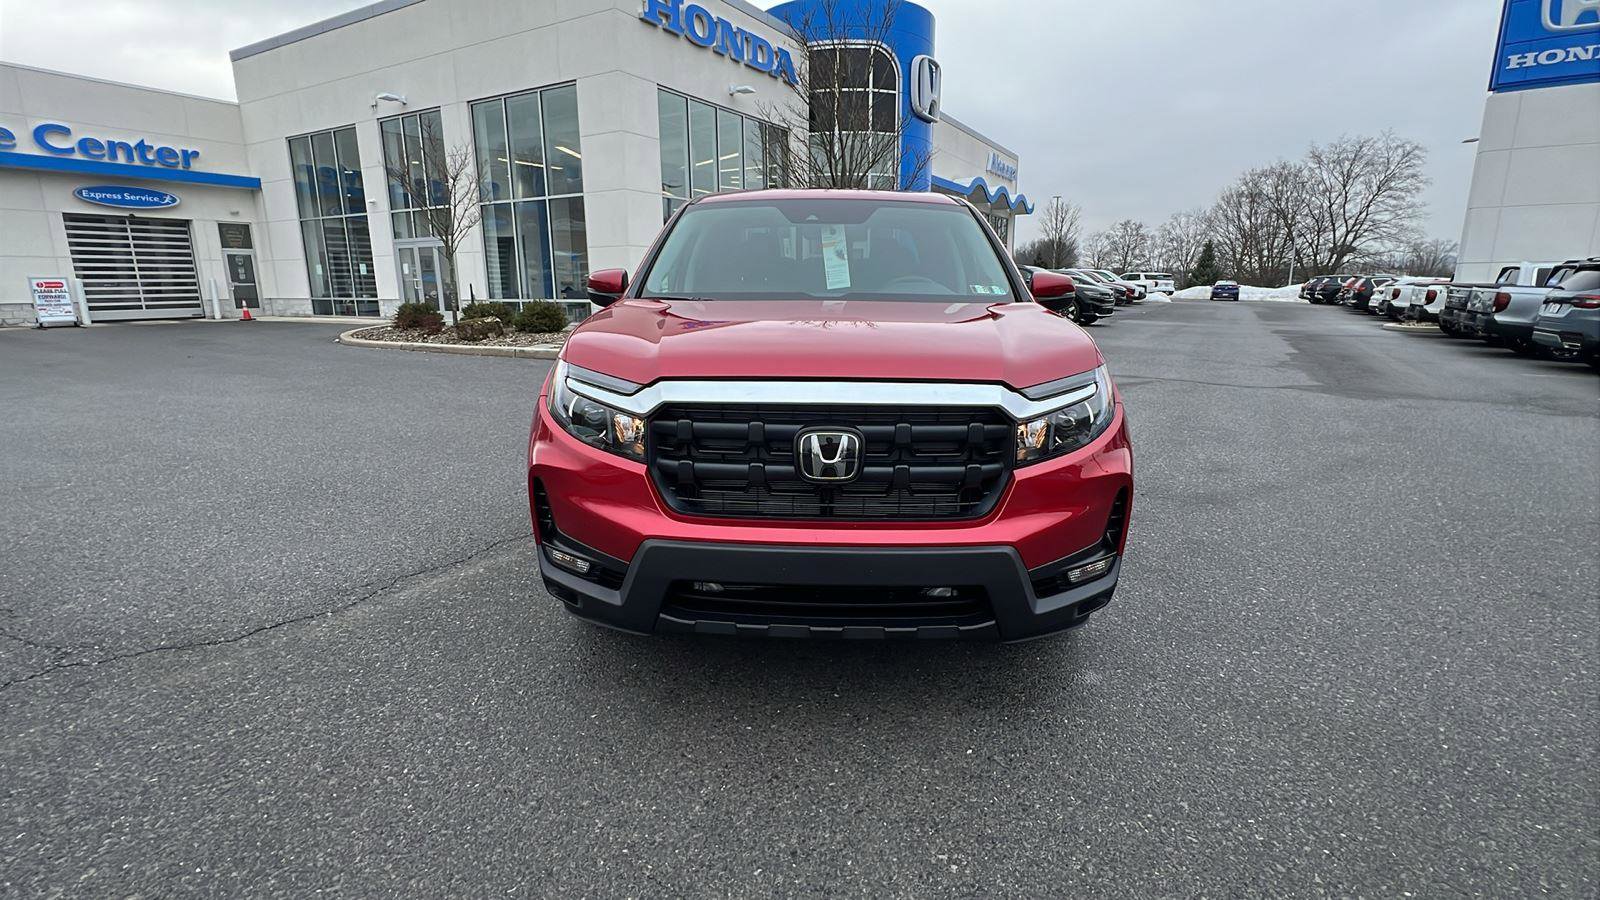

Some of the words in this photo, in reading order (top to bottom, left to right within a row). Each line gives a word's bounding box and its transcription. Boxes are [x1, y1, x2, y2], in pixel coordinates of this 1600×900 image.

[638, 0, 799, 85] HONDA
[1505, 44, 1600, 70] HON
[33, 123, 200, 169] Center
[82, 189, 122, 200] Express
[124, 192, 160, 202] Service
